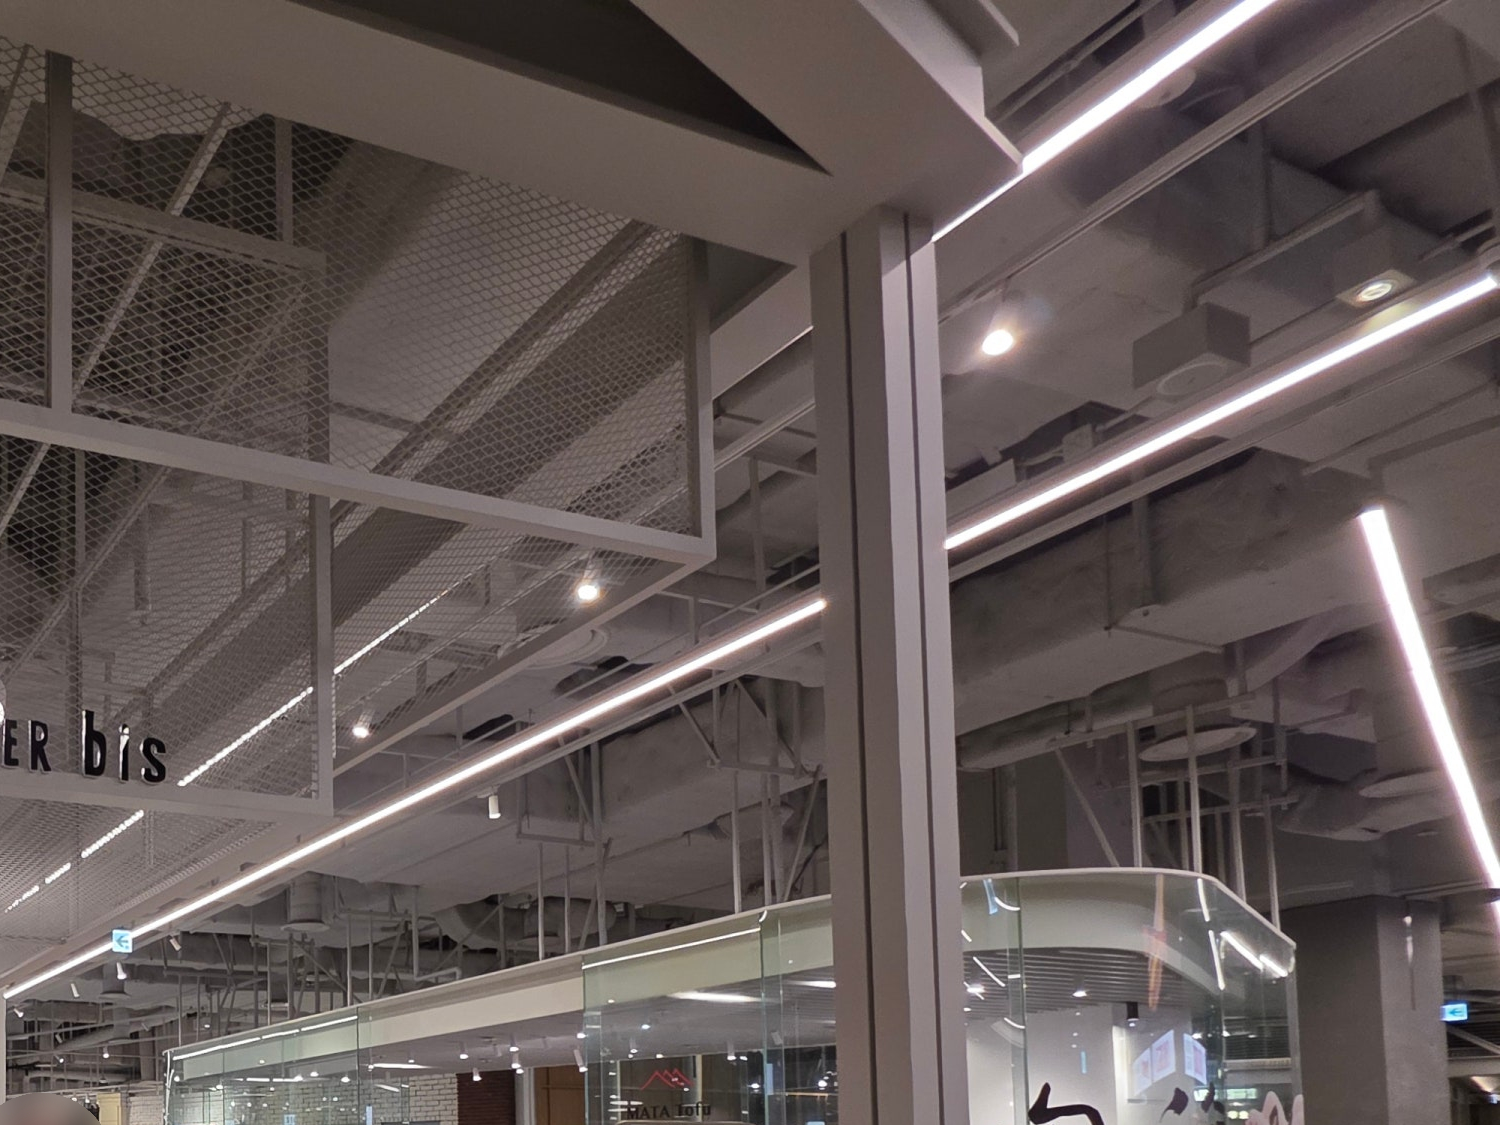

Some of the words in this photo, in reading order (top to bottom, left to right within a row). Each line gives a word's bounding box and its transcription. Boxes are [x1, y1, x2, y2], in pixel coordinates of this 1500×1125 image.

[81, 709, 167, 785] bis
[626, 1105, 670, 1120] MATA
[676, 1100, 712, 1118] Tofu
